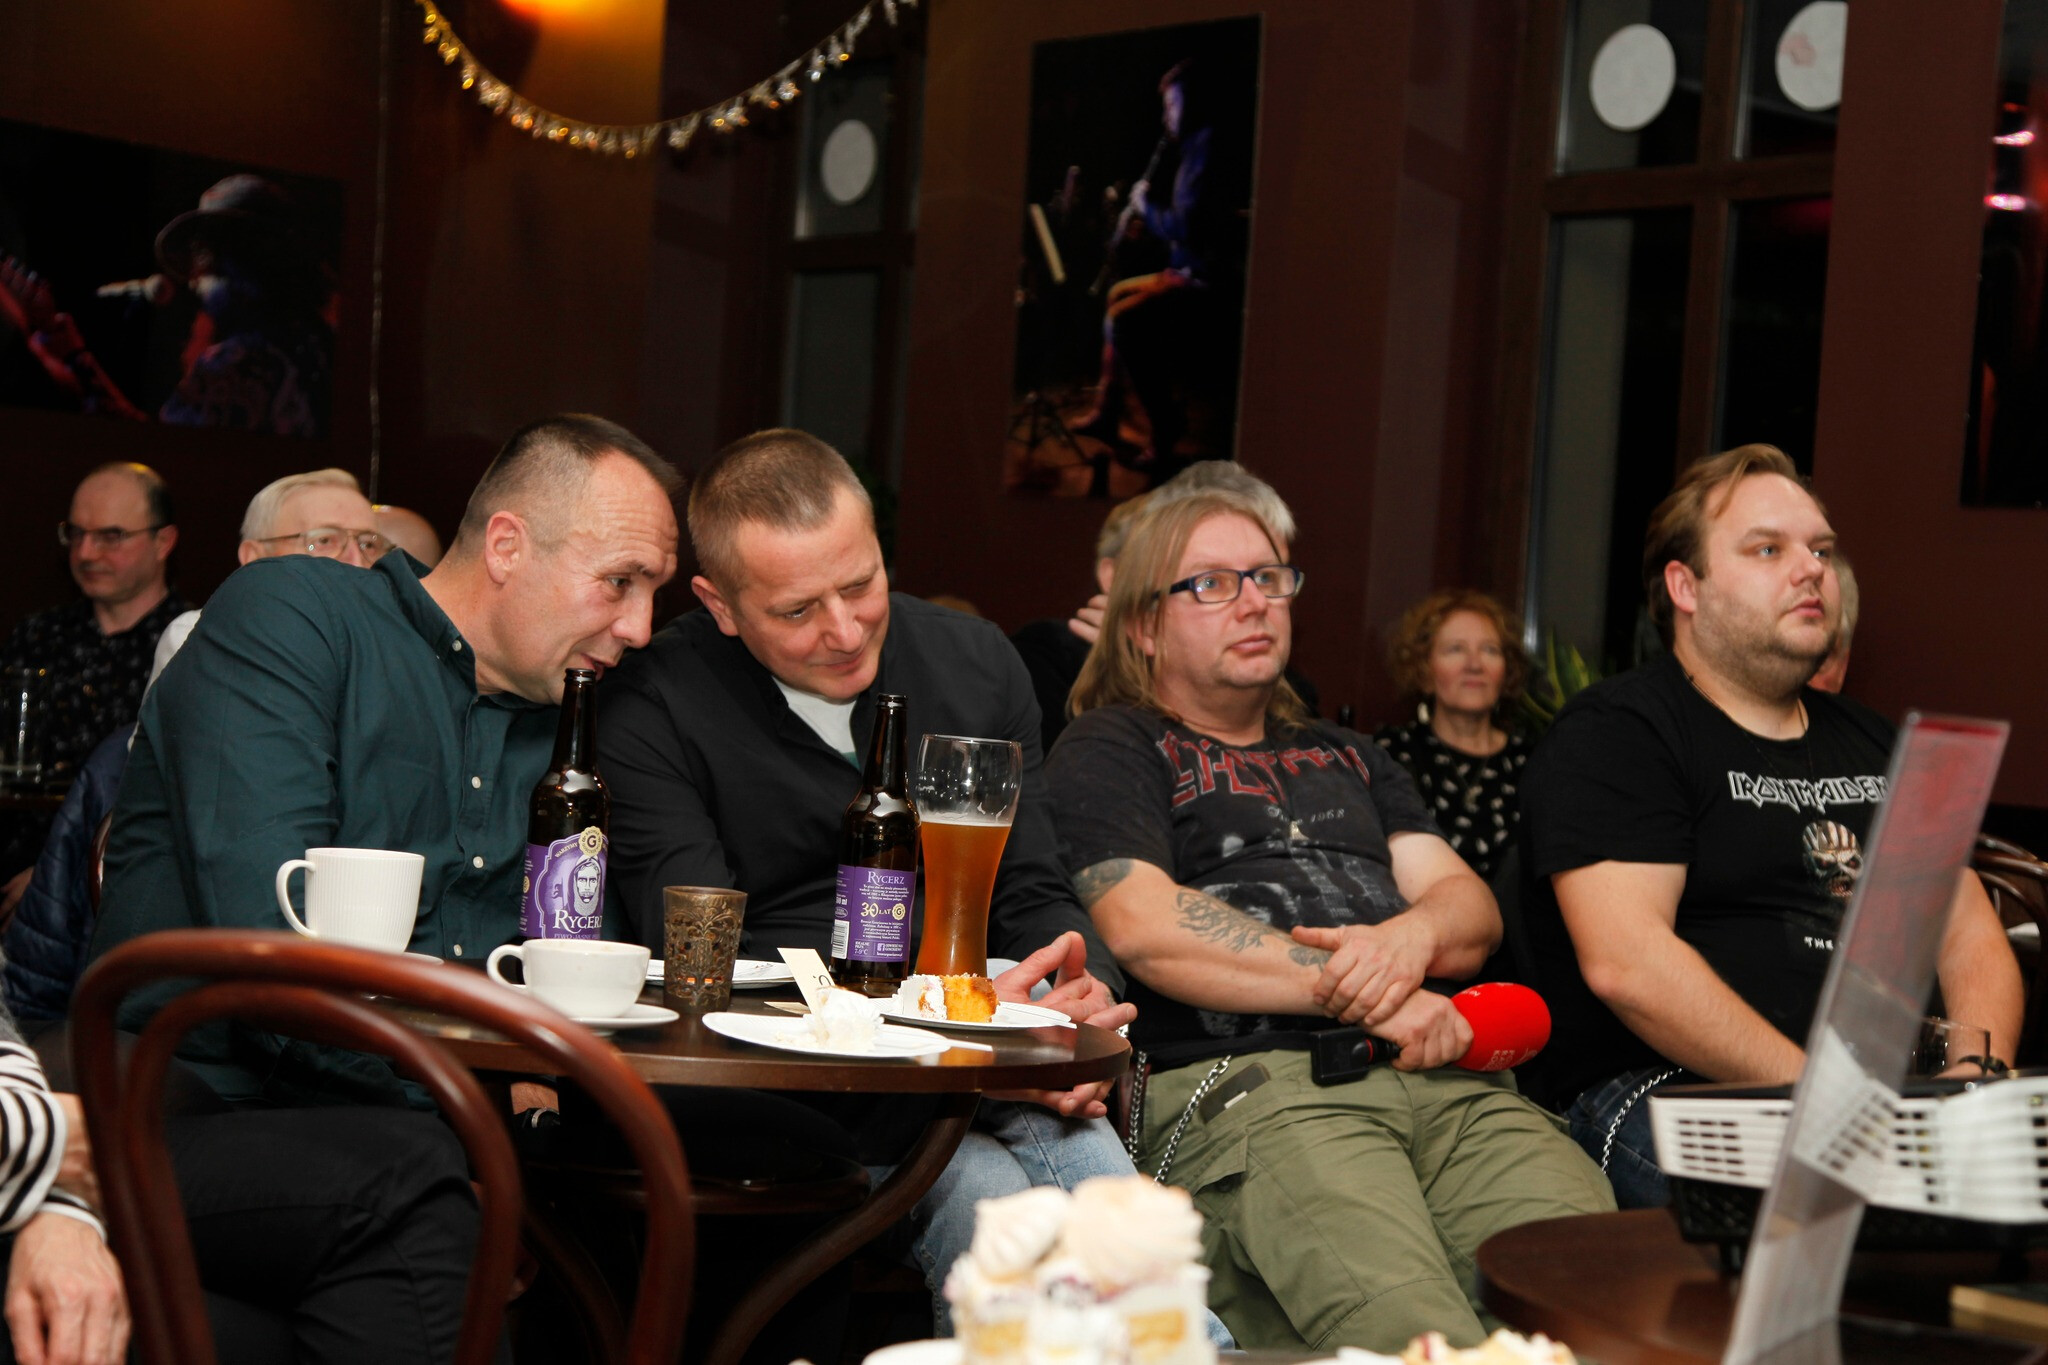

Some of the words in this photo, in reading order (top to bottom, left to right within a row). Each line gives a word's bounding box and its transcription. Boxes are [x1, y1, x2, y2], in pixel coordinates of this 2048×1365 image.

[1311, 808, 1345, 823] 1968
[587, 834, 598, 848] G
[867, 870, 905, 887] RYCERZ
[860, 902, 879, 917] 30
[1804, 936, 1834, 952] THE
